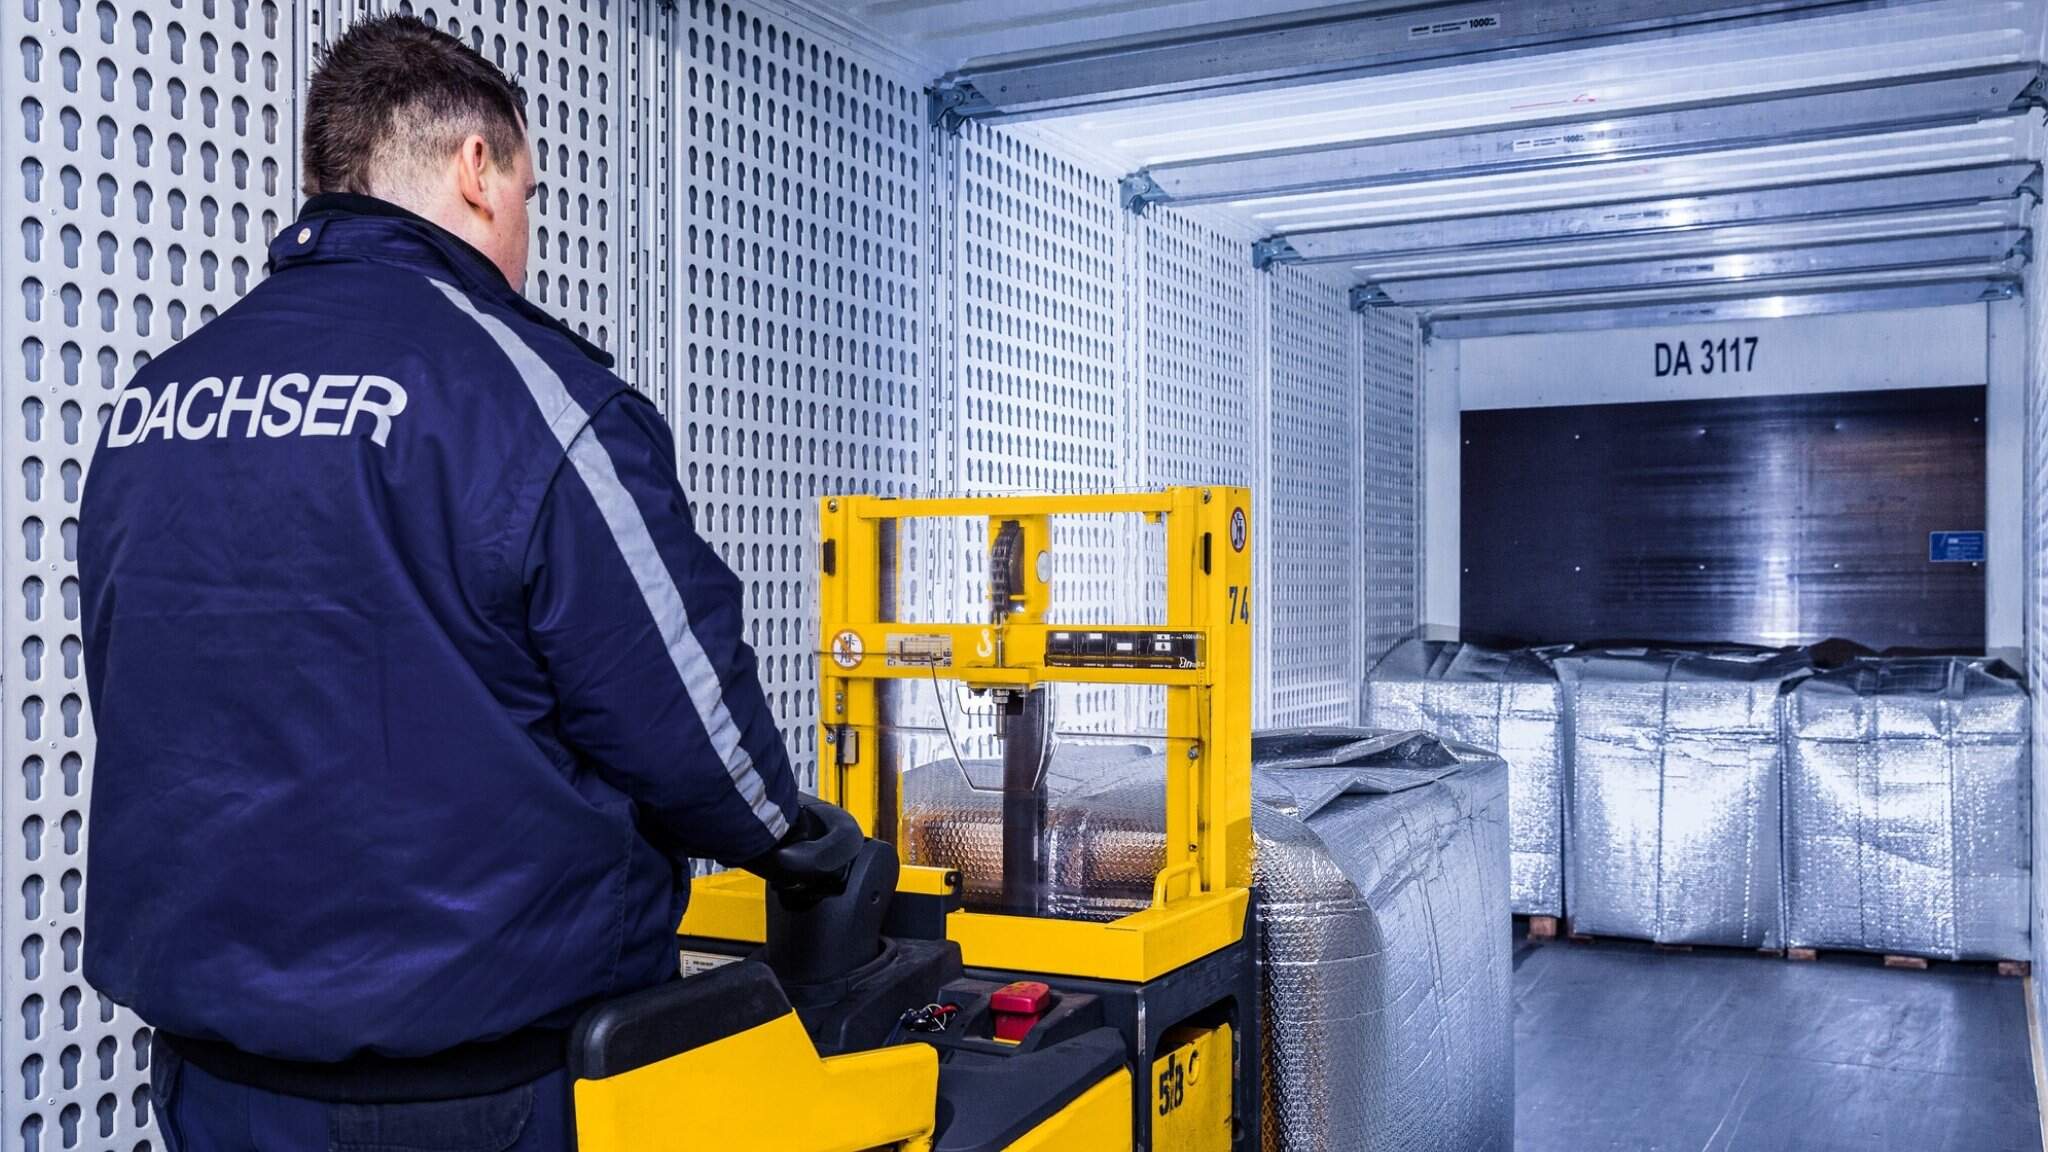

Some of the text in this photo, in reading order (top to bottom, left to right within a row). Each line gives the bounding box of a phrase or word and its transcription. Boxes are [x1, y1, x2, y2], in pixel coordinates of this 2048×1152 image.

[1655, 336, 1759, 377] DA 3117
[106, 372, 409, 449] DACHSER
[1228, 585, 1249, 625] 74
